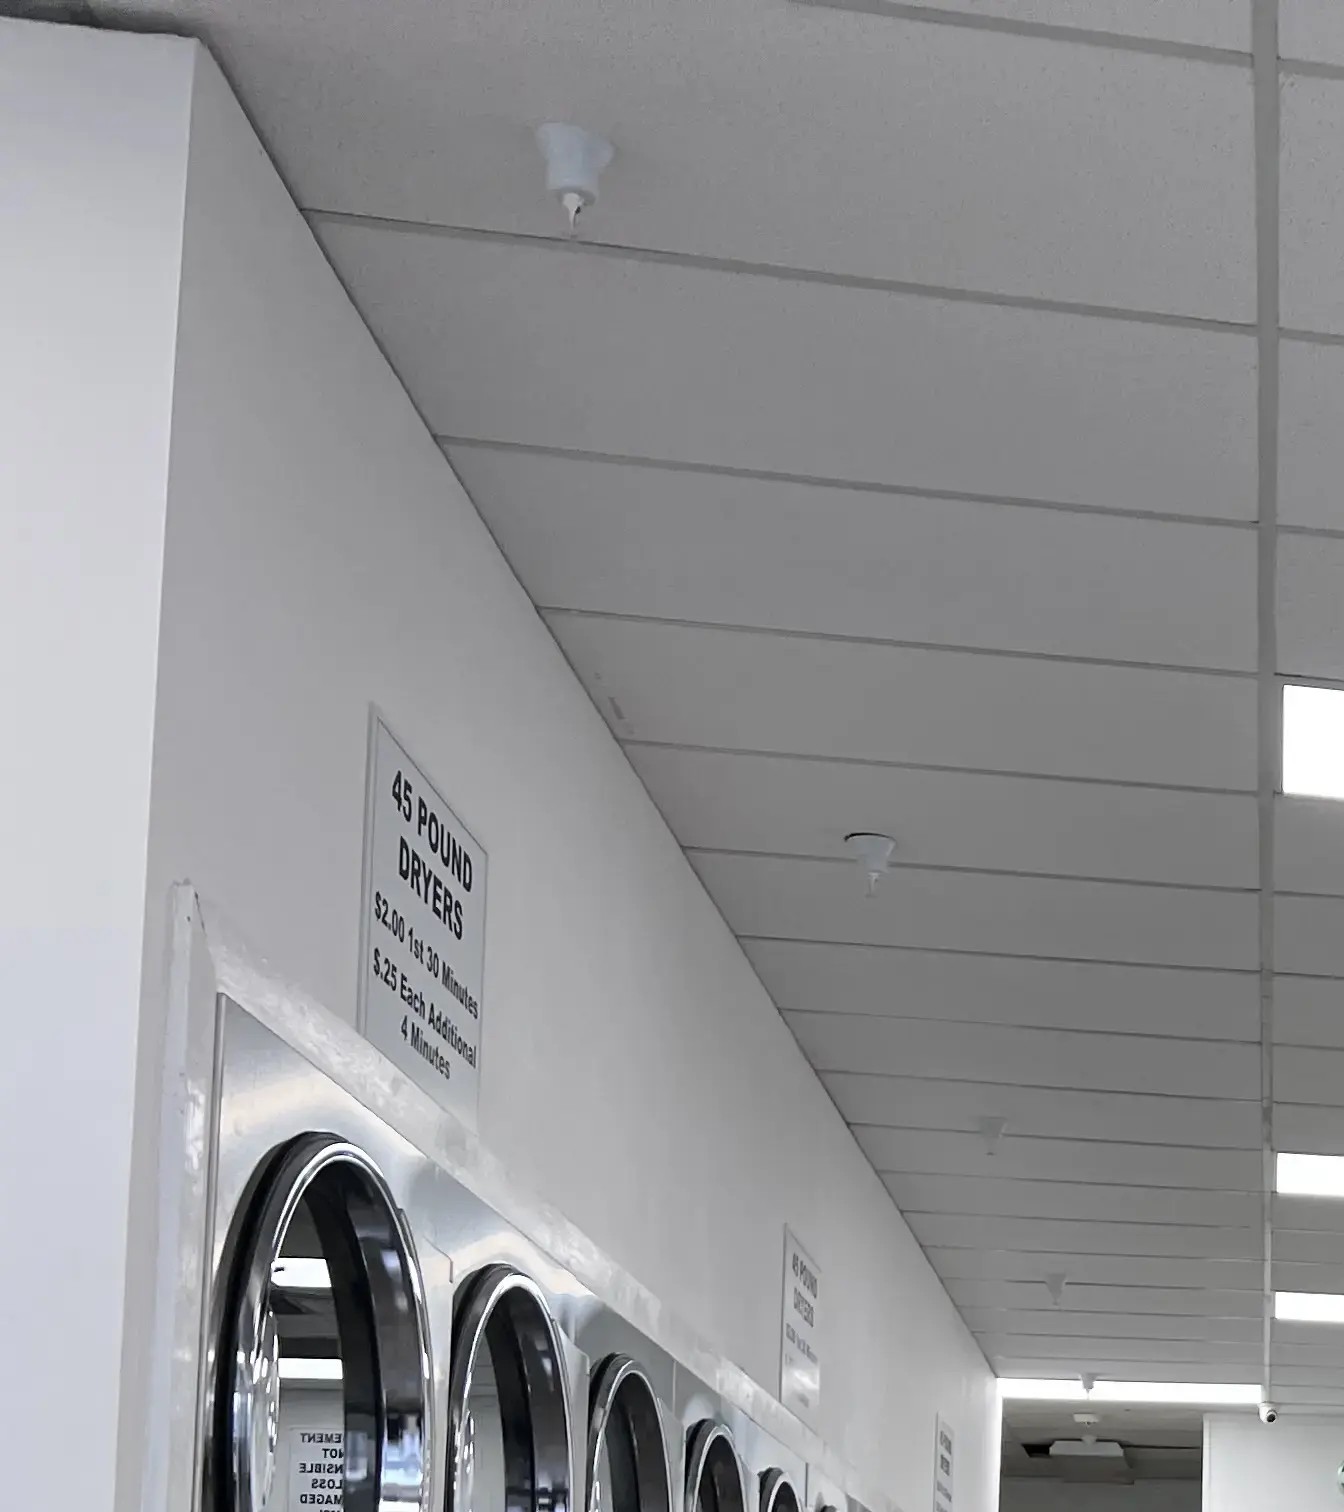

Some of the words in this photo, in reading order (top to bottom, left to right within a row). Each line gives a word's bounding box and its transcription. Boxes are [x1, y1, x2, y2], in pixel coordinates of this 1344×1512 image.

[391, 769, 413, 824] 45
[417, 795, 473, 894] POUND
[398, 834, 464, 942] DRYERS
[372, 946, 398, 993] $.25
[399, 971, 426, 1020] Each
[427, 1001, 478, 1069] Additional
[374, 890, 405, 944] $2.00
[407, 925, 424, 965] 1st
[426, 943, 440, 980] 30
[441, 956, 479, 1022] Minutes
[400, 1014, 409, 1042] 4
[410, 1024, 451, 1082] Minutes
